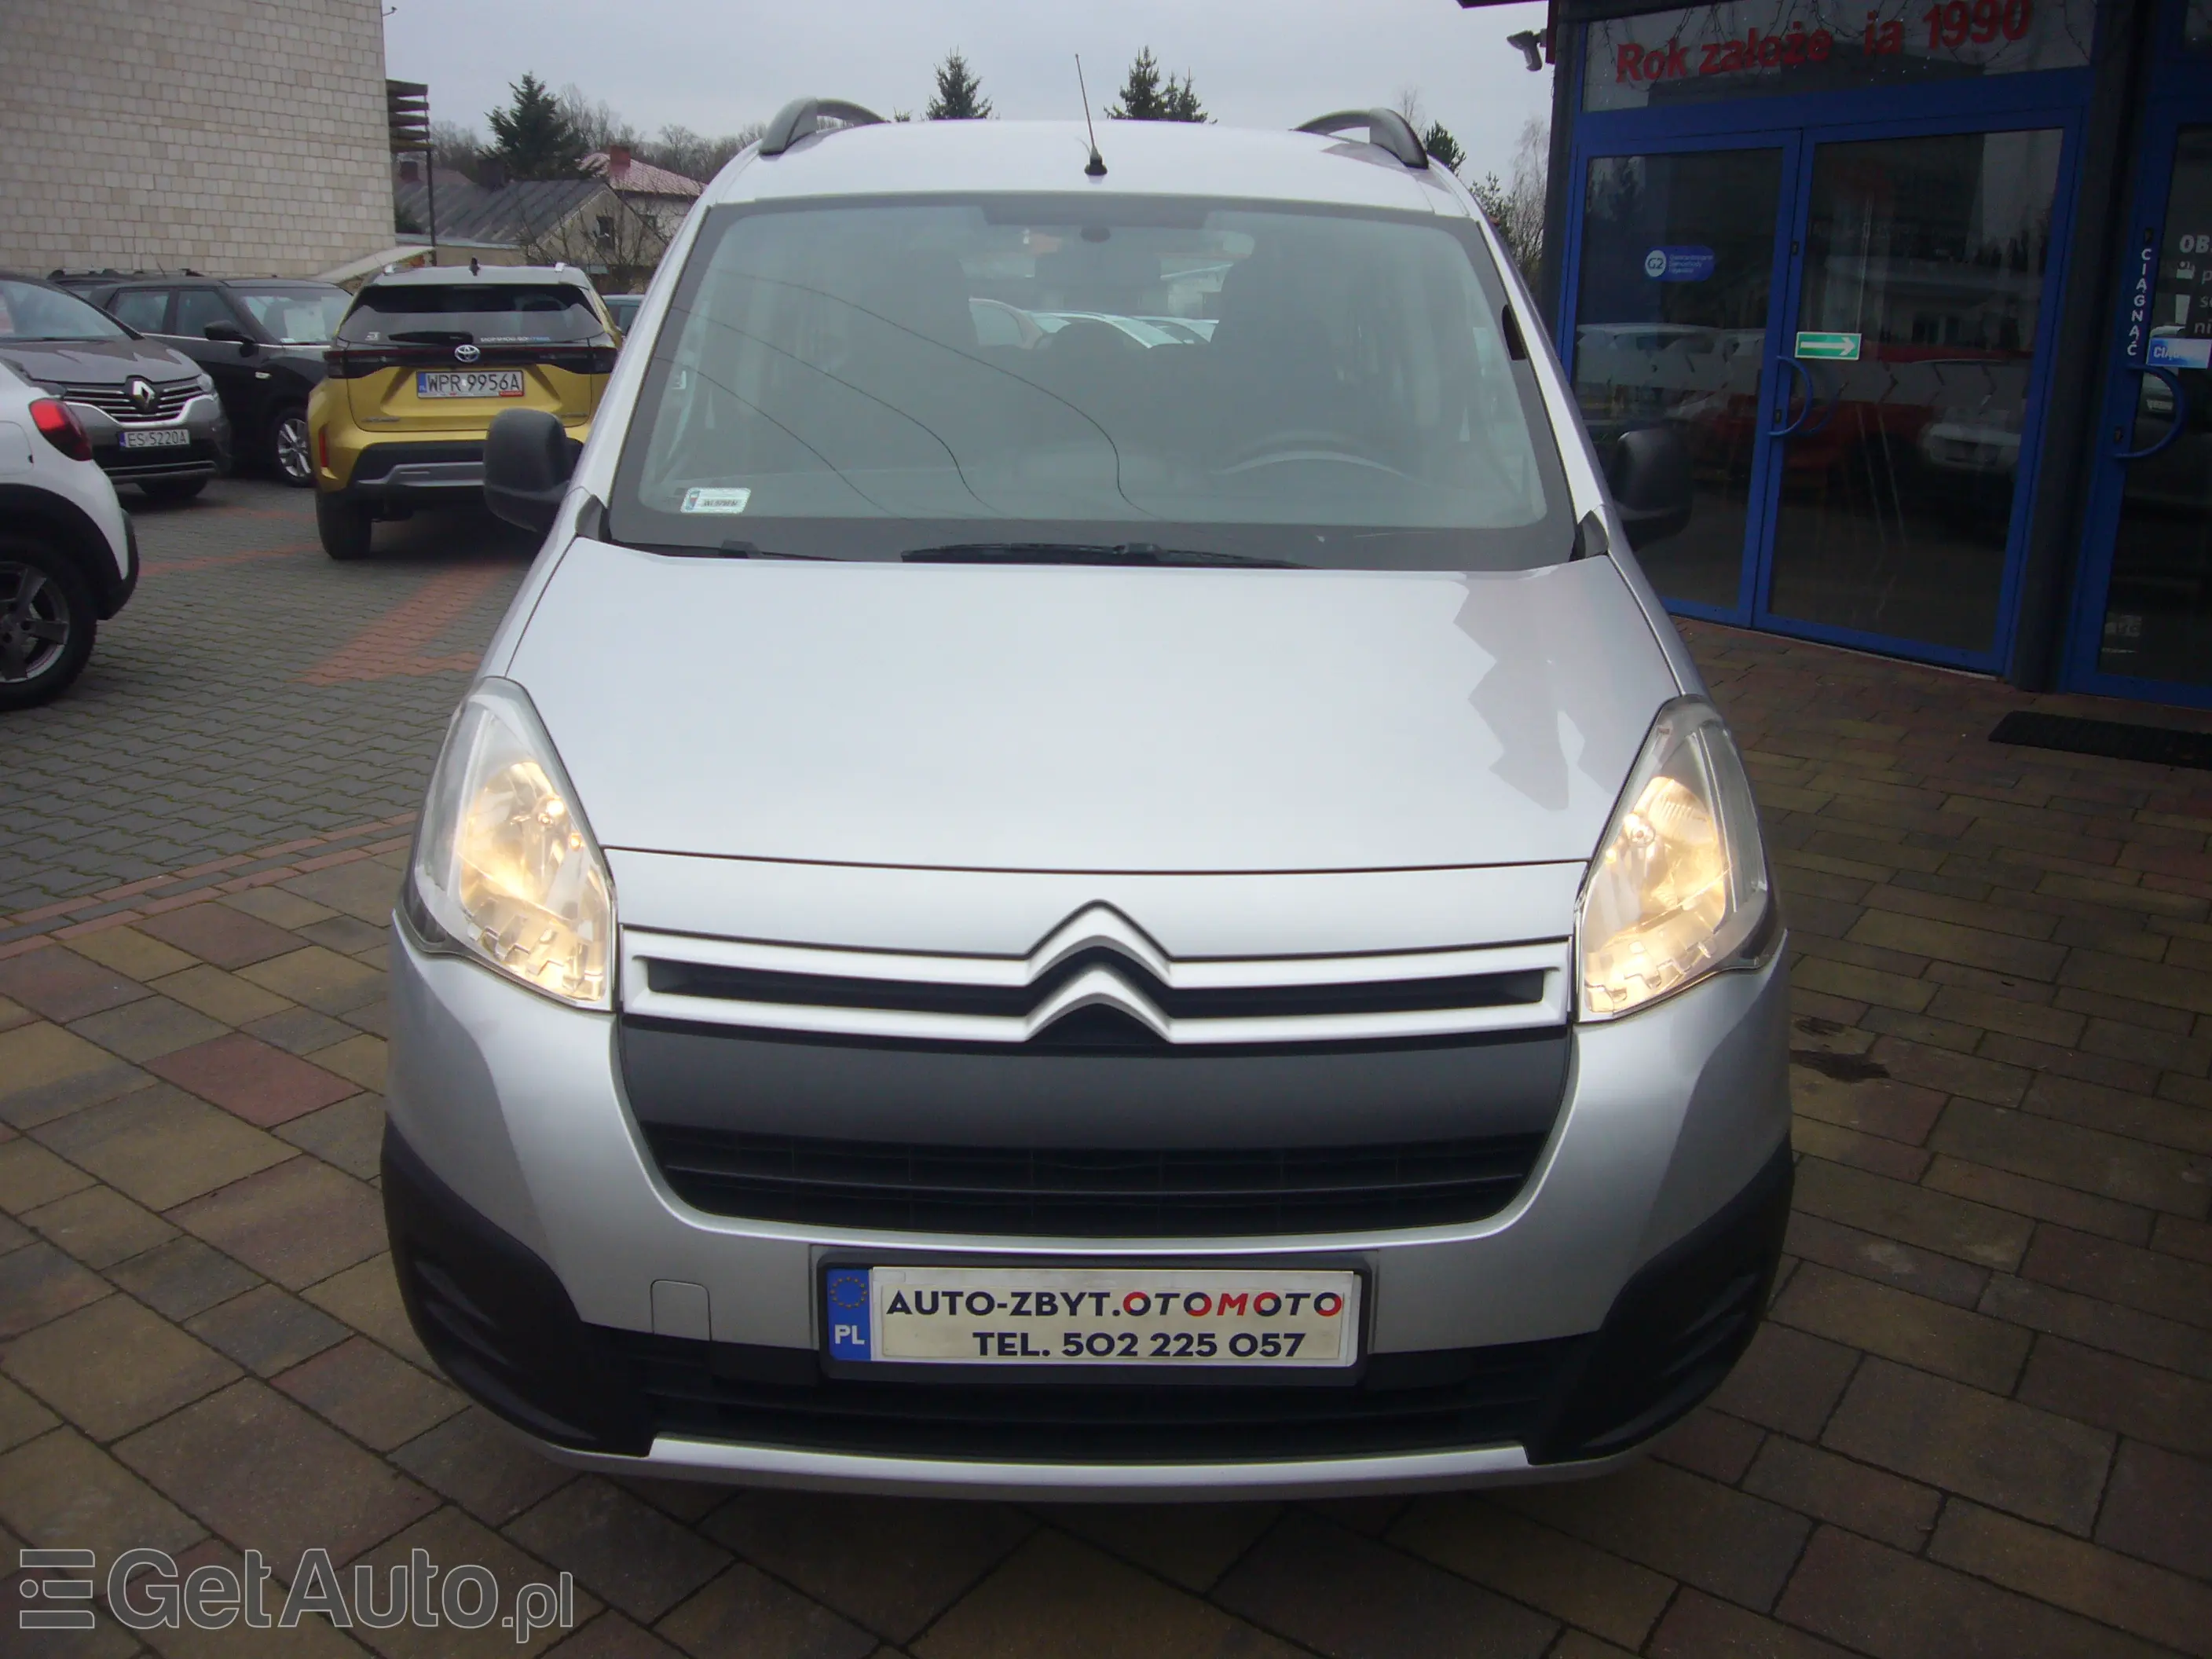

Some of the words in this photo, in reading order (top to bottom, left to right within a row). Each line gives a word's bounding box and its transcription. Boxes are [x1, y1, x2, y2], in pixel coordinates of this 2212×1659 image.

[1616, 37, 1690, 83] Rok
[1923, 0, 2034, 50] 1990
[2126, 249, 2152, 356] CIĄGNĄĆ
[427, 374, 462, 392] WPR
[467, 373, 521, 391] 9956A
[127, 433, 146, 447] ES
[148, 430, 187, 445] 5220A
[886, 1290, 1342, 1317] AUTO-ZBYT.OTOMOTO
[834, 1324, 865, 1344] PL
[972, 1332, 1050, 1357] TEL.
[1062, 1332, 1138, 1357] 502
[1149, 1333, 1218, 1357] 225
[1229, 1333, 1306, 1357] 057
